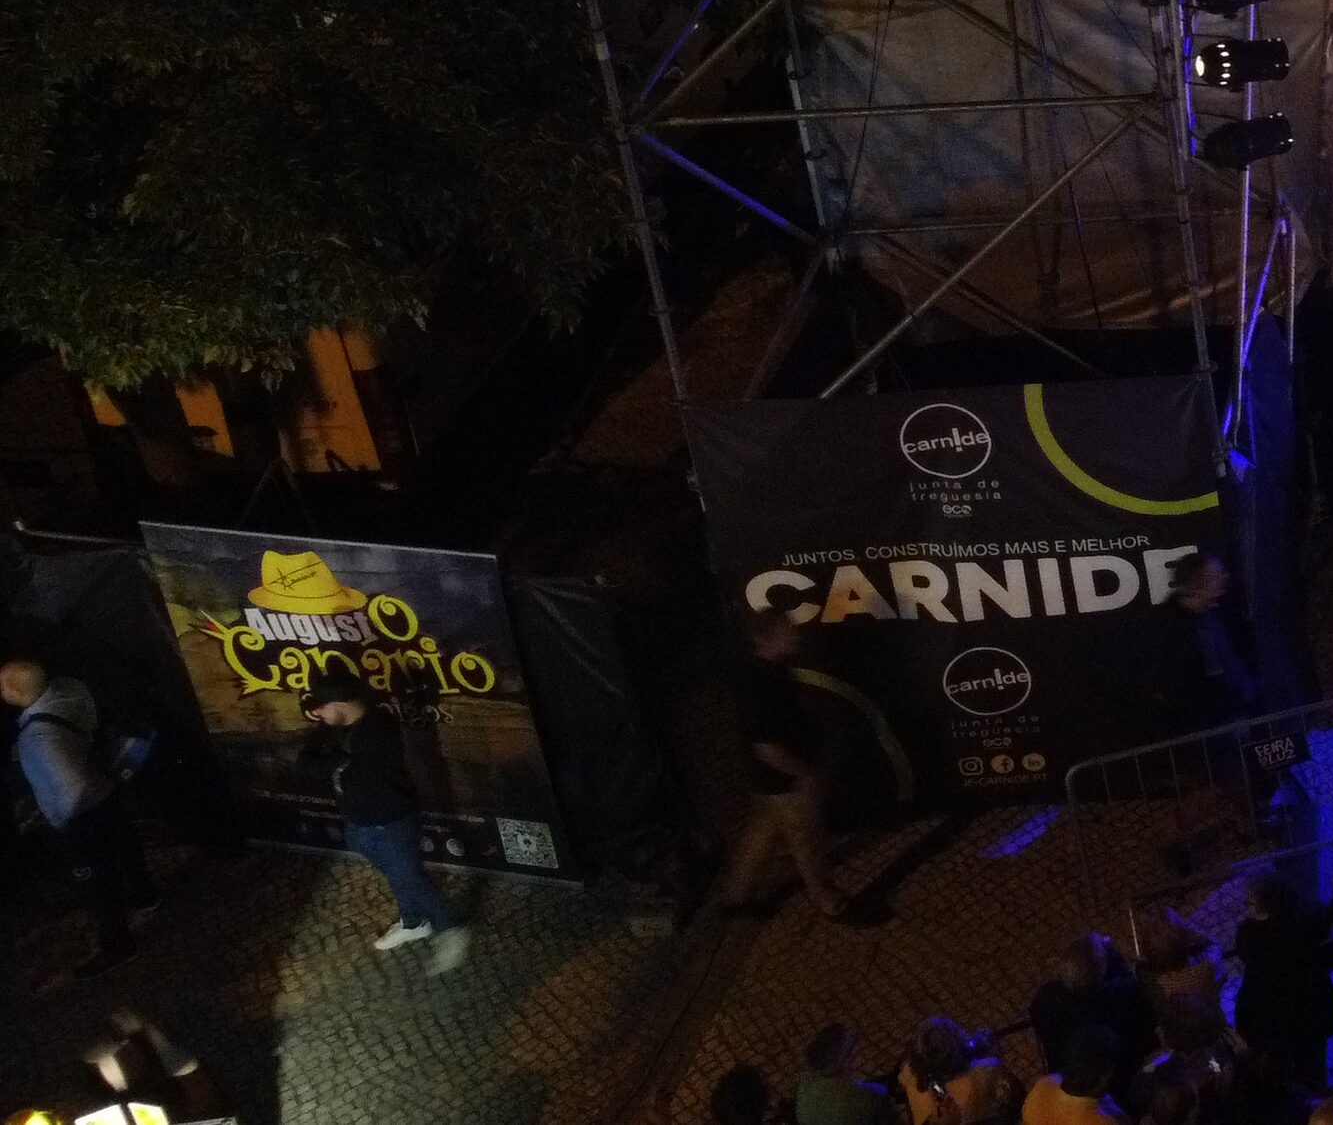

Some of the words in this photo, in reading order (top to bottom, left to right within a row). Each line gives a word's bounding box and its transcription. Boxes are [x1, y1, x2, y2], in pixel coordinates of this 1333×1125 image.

[977, 479, 1000, 489] de
[864, 542, 1001, 560] CONSTRUÍMOS
[1004, 540, 1051, 555] MAIS
[1055, 540, 1067, 553] E
[1071, 535, 1151, 553] MELHOR
[745, 544, 1198, 625] CARNIDE
[1254, 736, 1295, 757] FEIRA
